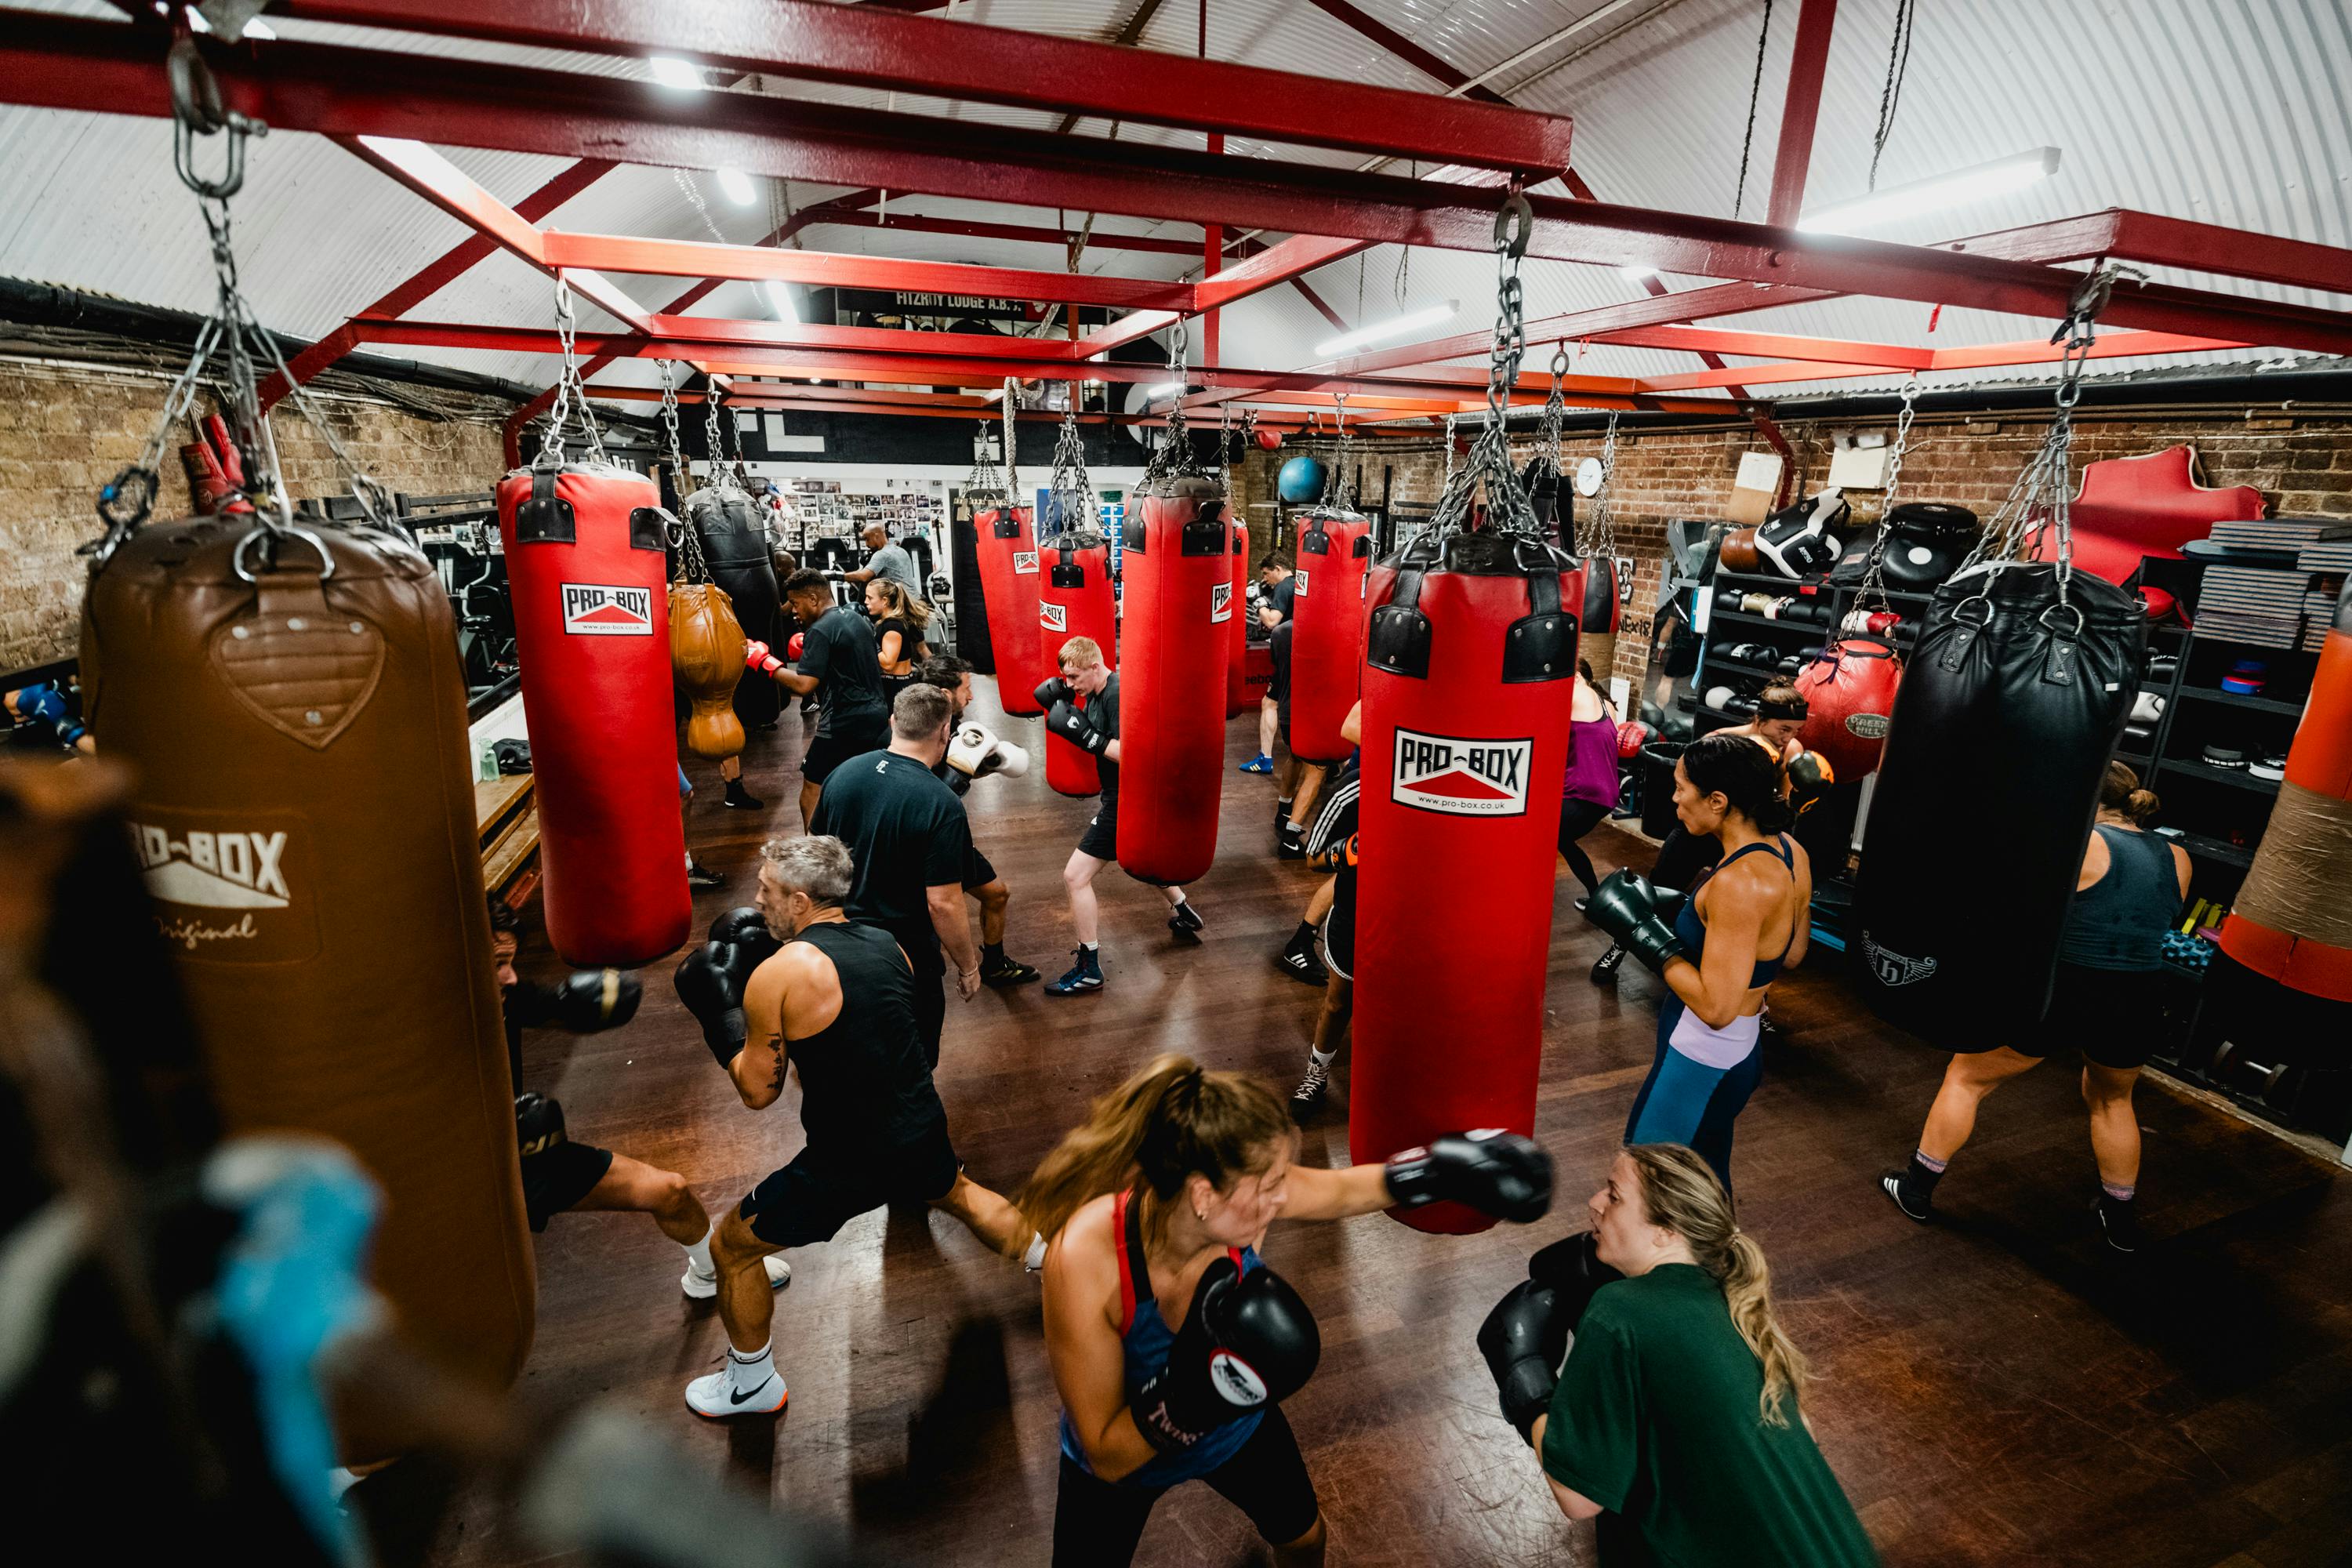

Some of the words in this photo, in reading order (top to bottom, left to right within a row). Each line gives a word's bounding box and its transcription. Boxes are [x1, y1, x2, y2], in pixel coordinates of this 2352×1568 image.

[566, 588, 648, 620] PRO-BOX
[1399, 738, 1523, 793] PRO-BOX
[1417, 795, 1505, 811] www.pro-box.co.uk
